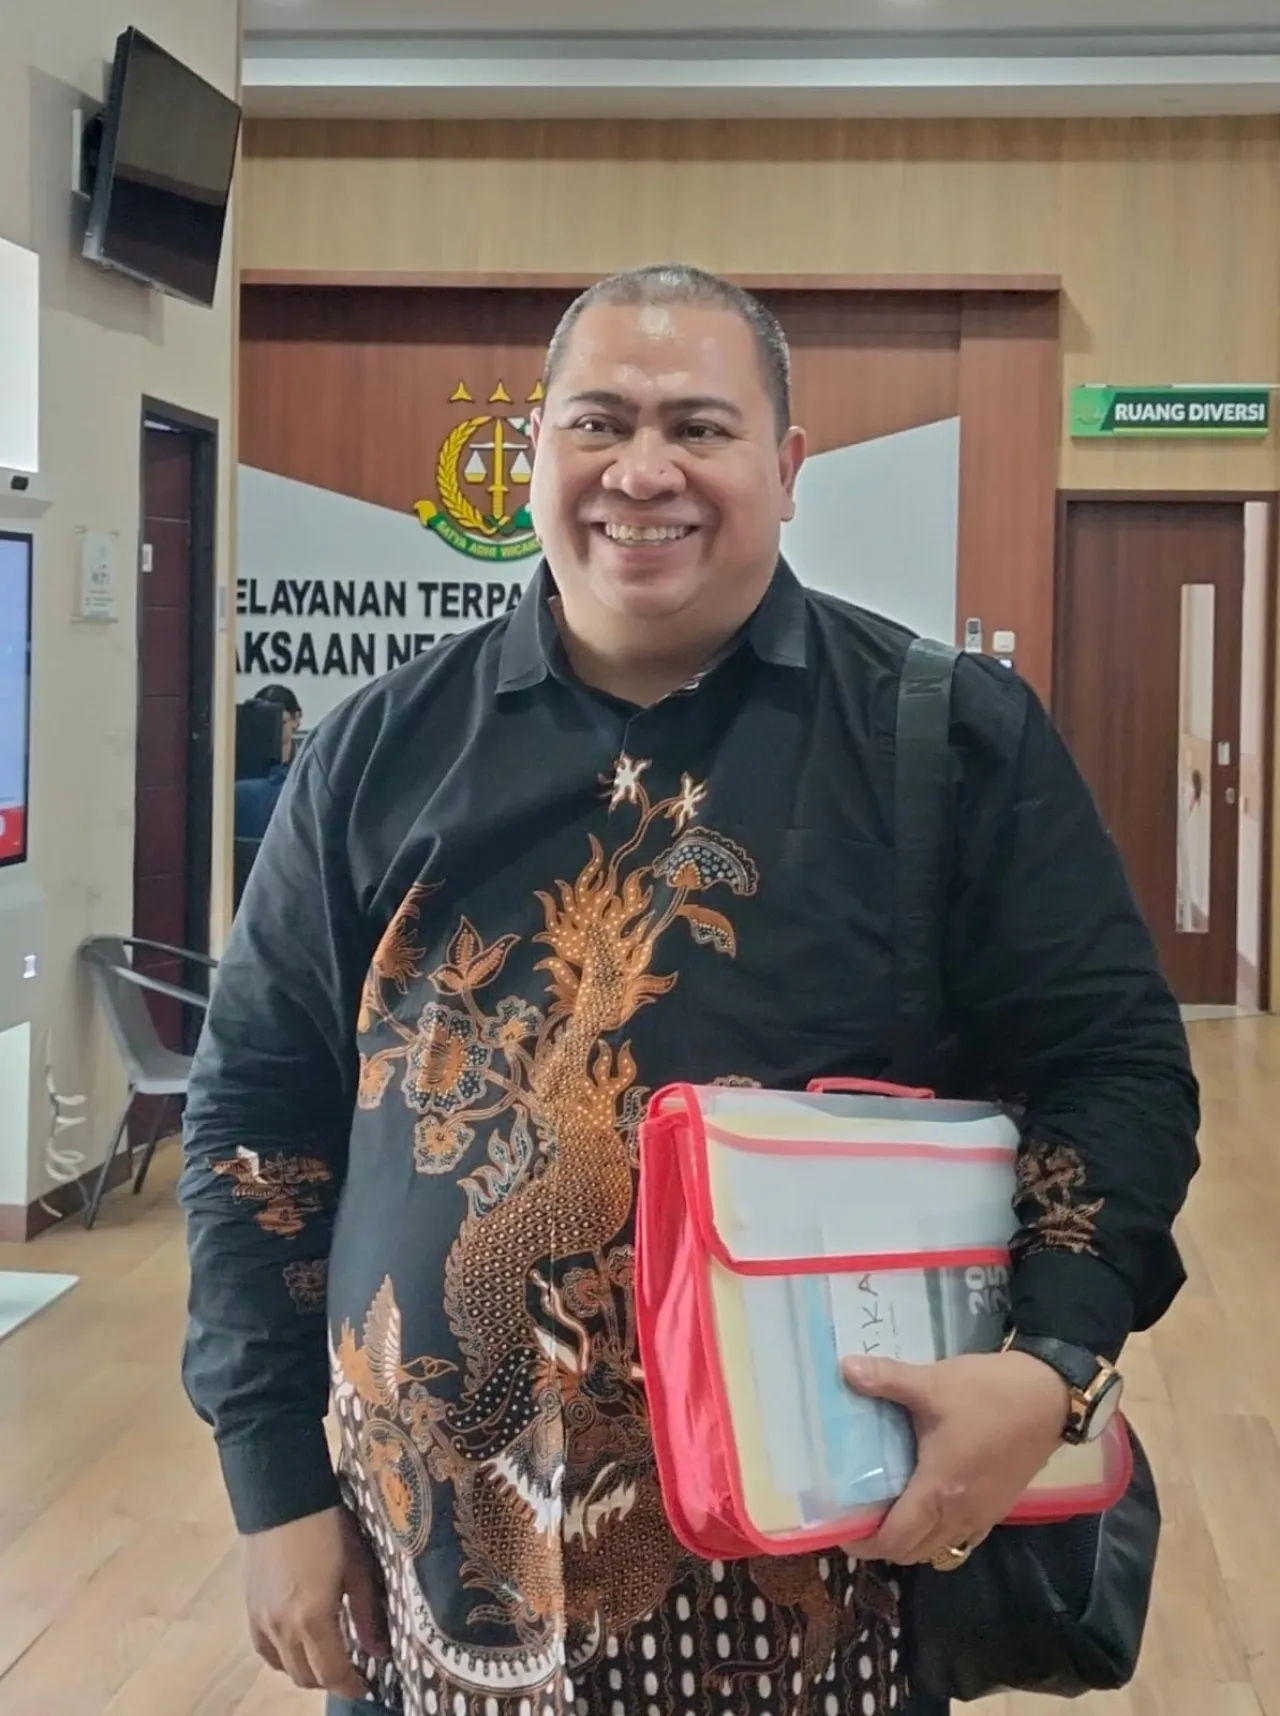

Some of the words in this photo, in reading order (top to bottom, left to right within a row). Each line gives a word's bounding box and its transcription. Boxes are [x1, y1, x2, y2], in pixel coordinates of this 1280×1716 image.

[1114, 403, 1185, 421] RUANG
[1188, 403, 1265, 421] DIVERSI
[236, 631, 376, 676] KSAAN
